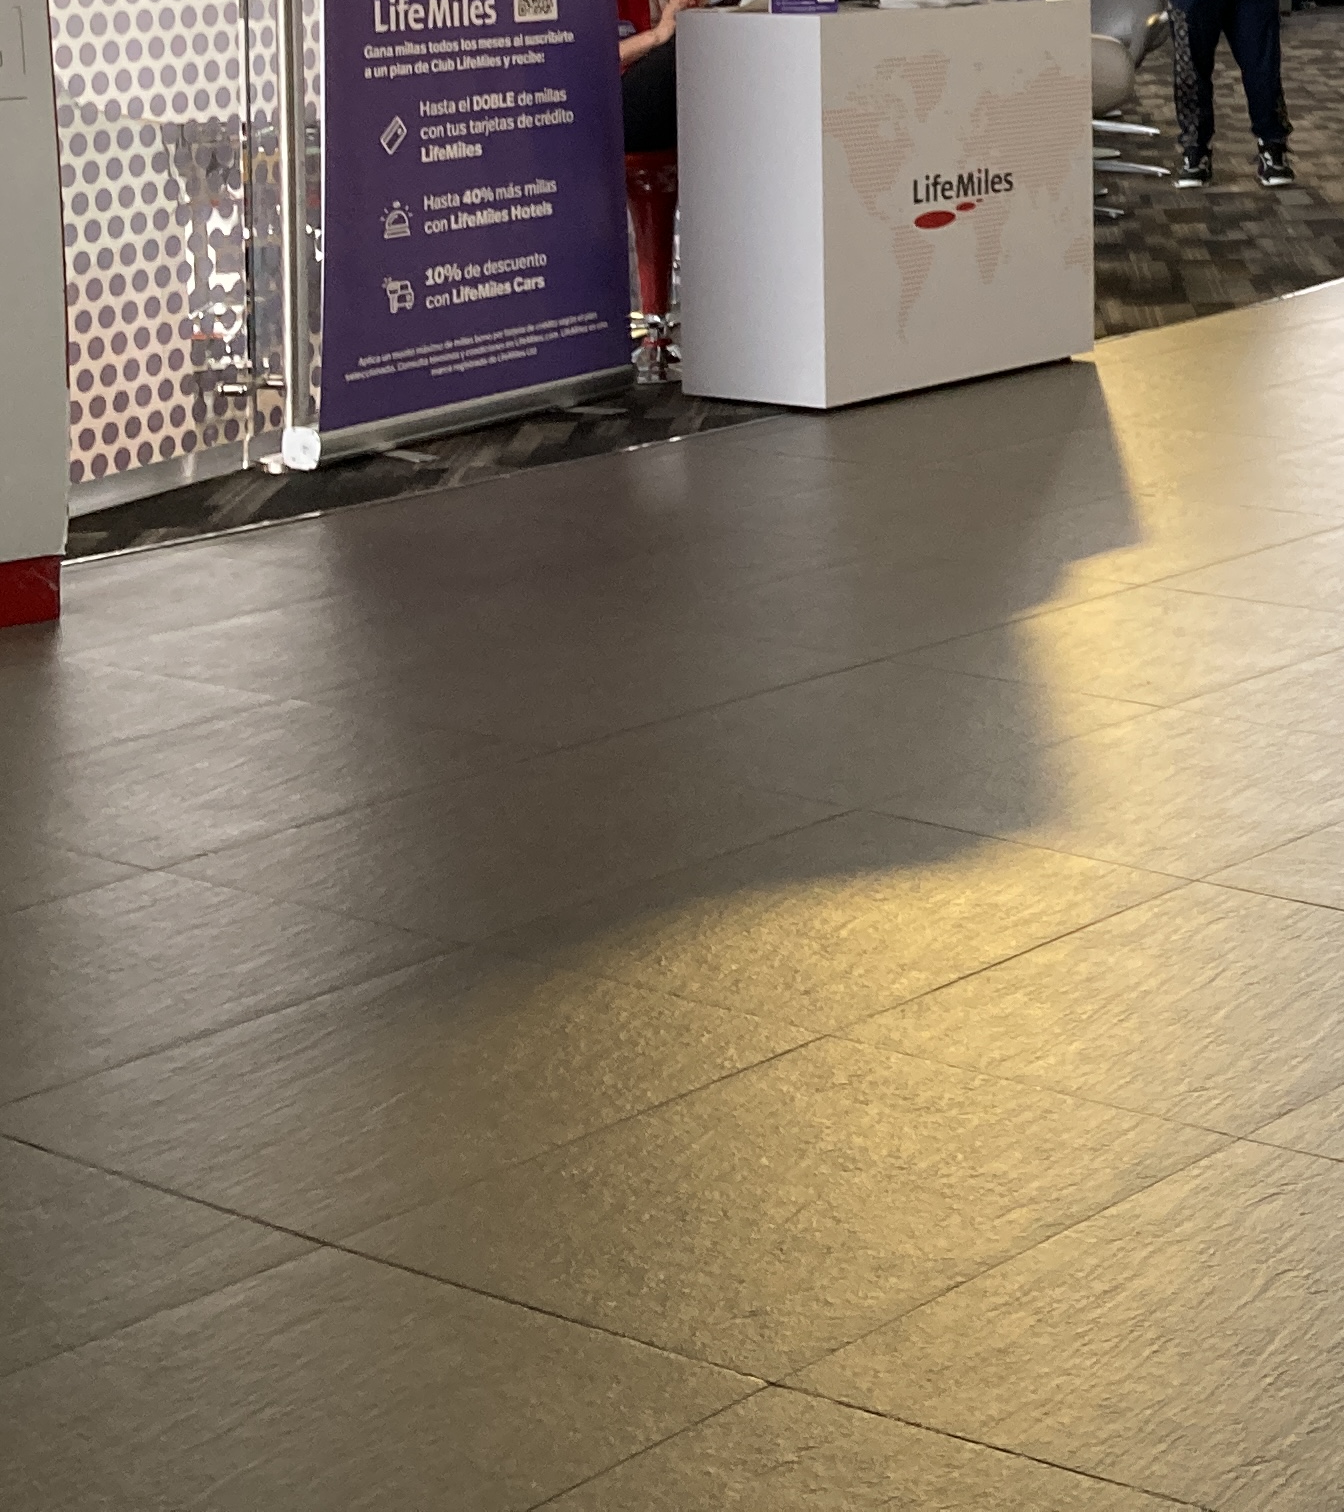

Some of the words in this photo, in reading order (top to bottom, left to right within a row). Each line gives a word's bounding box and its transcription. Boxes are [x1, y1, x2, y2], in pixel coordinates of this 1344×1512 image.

[419, 99, 457, 117] Hasta
[473, 91, 515, 111] DOBLE
[517, 90, 533, 106] de
[535, 88, 567, 105] millas
[420, 126, 444, 140] con
[446, 121, 467, 137] tus
[469, 116, 515, 136] tarjetas
[517, 113, 533, 129] de
[534, 108, 574, 126] crédito
[423, 193, 461, 211] Hasta
[462, 186, 494, 205] 40%
[495, 182, 522, 200] más
[913, 168, 1014, 205] LifeMiles
[424, 218, 448, 234] con
[425, 263, 462, 286] 10%
[464, 263, 481, 279] de
[483, 252, 547, 276] descuento
[425, 292, 450, 309] con
[513, 276, 545, 293] Cars
